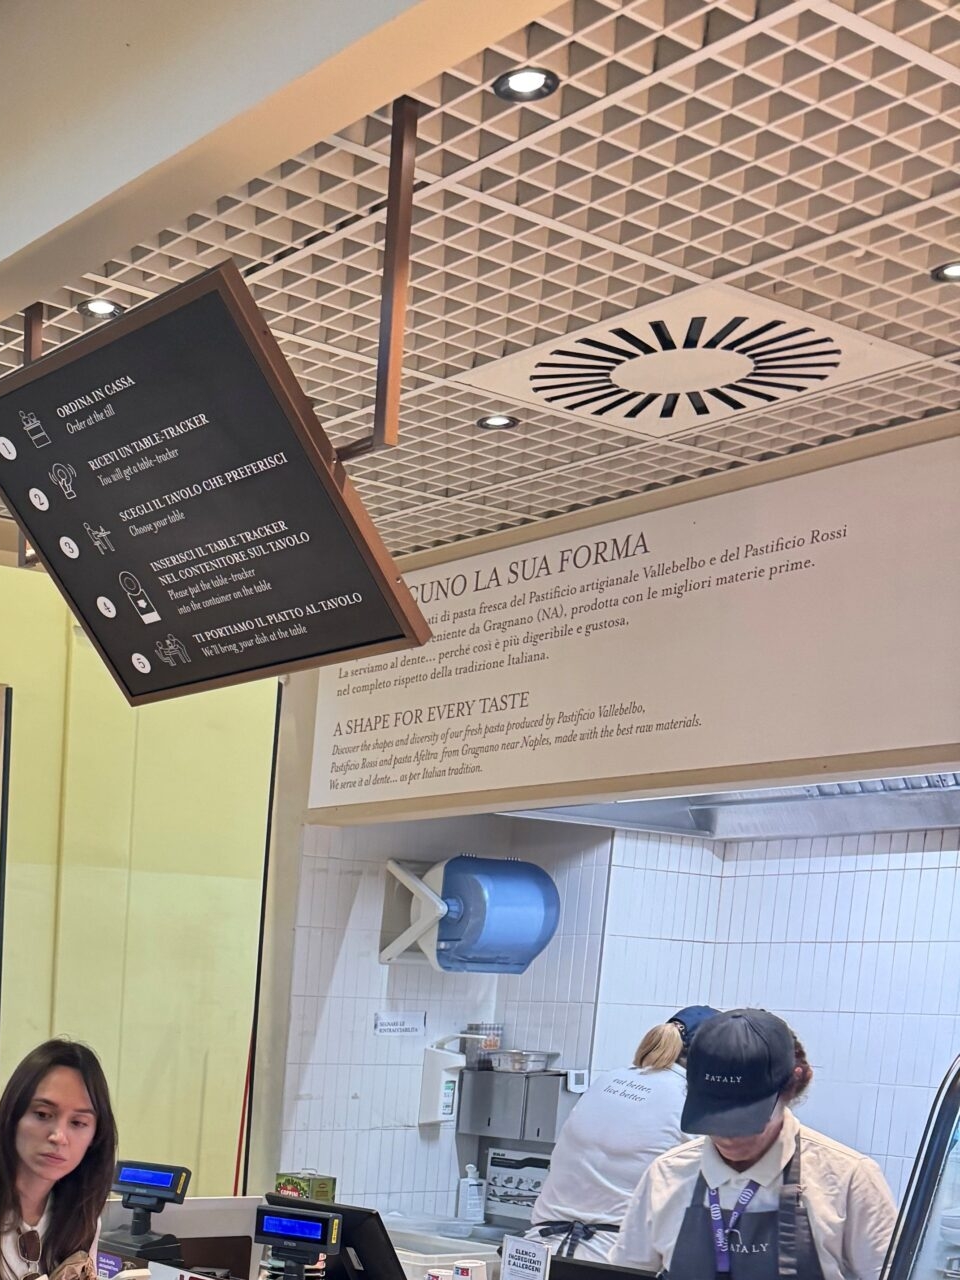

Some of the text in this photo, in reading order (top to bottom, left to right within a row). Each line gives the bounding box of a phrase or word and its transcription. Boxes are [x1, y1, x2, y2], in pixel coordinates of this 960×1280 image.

[56, 375, 135, 417] ORDINA IN CASSA
[87, 413, 209, 470] RICEVI UN TABLE-TRACKER
[118, 452, 288, 522] SCEGLI IL TAVOLO CHE PREFERISCI
[149, 520, 288, 571] INSERISCI IL TABLE TRACKER
[158, 531, 309, 585] NEL CONTENITORE SUL TAVOLO
[472, 566, 502, 592] LA
[507, 554, 552, 584] SUA
[557, 531, 650, 573] FORMA
[440, 609, 450, 622] di
[452, 607, 476, 623] pasta
[479, 601, 507, 614] fresca
[509, 592, 525, 607] del
[528, 584, 577, 603] Pastificio
[579, 569, 639, 593] artigianale
[642, 556, 705, 578] Vallebelbo
[708, 556, 716, 565] e
[719, 546, 740, 563] del
[743, 535, 805, 558] Pastificio
[809, 523, 847, 544] Rossi
[468, 624, 481, 635] da
[484, 614, 534, 633] Gragnano
[570, 597, 618, 619] prodotta
[621, 592, 643, 605] con
[646, 586, 658, 599] le
[660, 575, 711, 597] migliori
[715, 565, 765, 586] materie
[768, 559, 815, 579] prime.
[191, 592, 362, 643] TI PORTIAMO IL PIATTO AL TAVOLO
[336, 651, 549, 696] nel completo rispetto della tradizione Italiana.
[338, 617, 629, 679] La serviamo al dente... perché così è più digeribile e gustosa,
[331, 703, 645, 755] Discover the shapes and diversity of our fresh pasta produced by Pastificio Vallebelbo,
[333, 691, 530, 737] A SHAPE FOR EVERY TASTE
[330, 714, 701, 775] Pastificio Rossi and pasta Afeltra from Gragnano near Naples, made with the best raw materials.
[705, 1073, 742, 1083] EATALY
[508, 1253, 542, 1267] INGREDIENTI
[512, 1261, 541, 1273] ALLERGENI
[515, 1249, 536, 1258] ELENCO
[730, 1243, 769, 1254] ATALY
